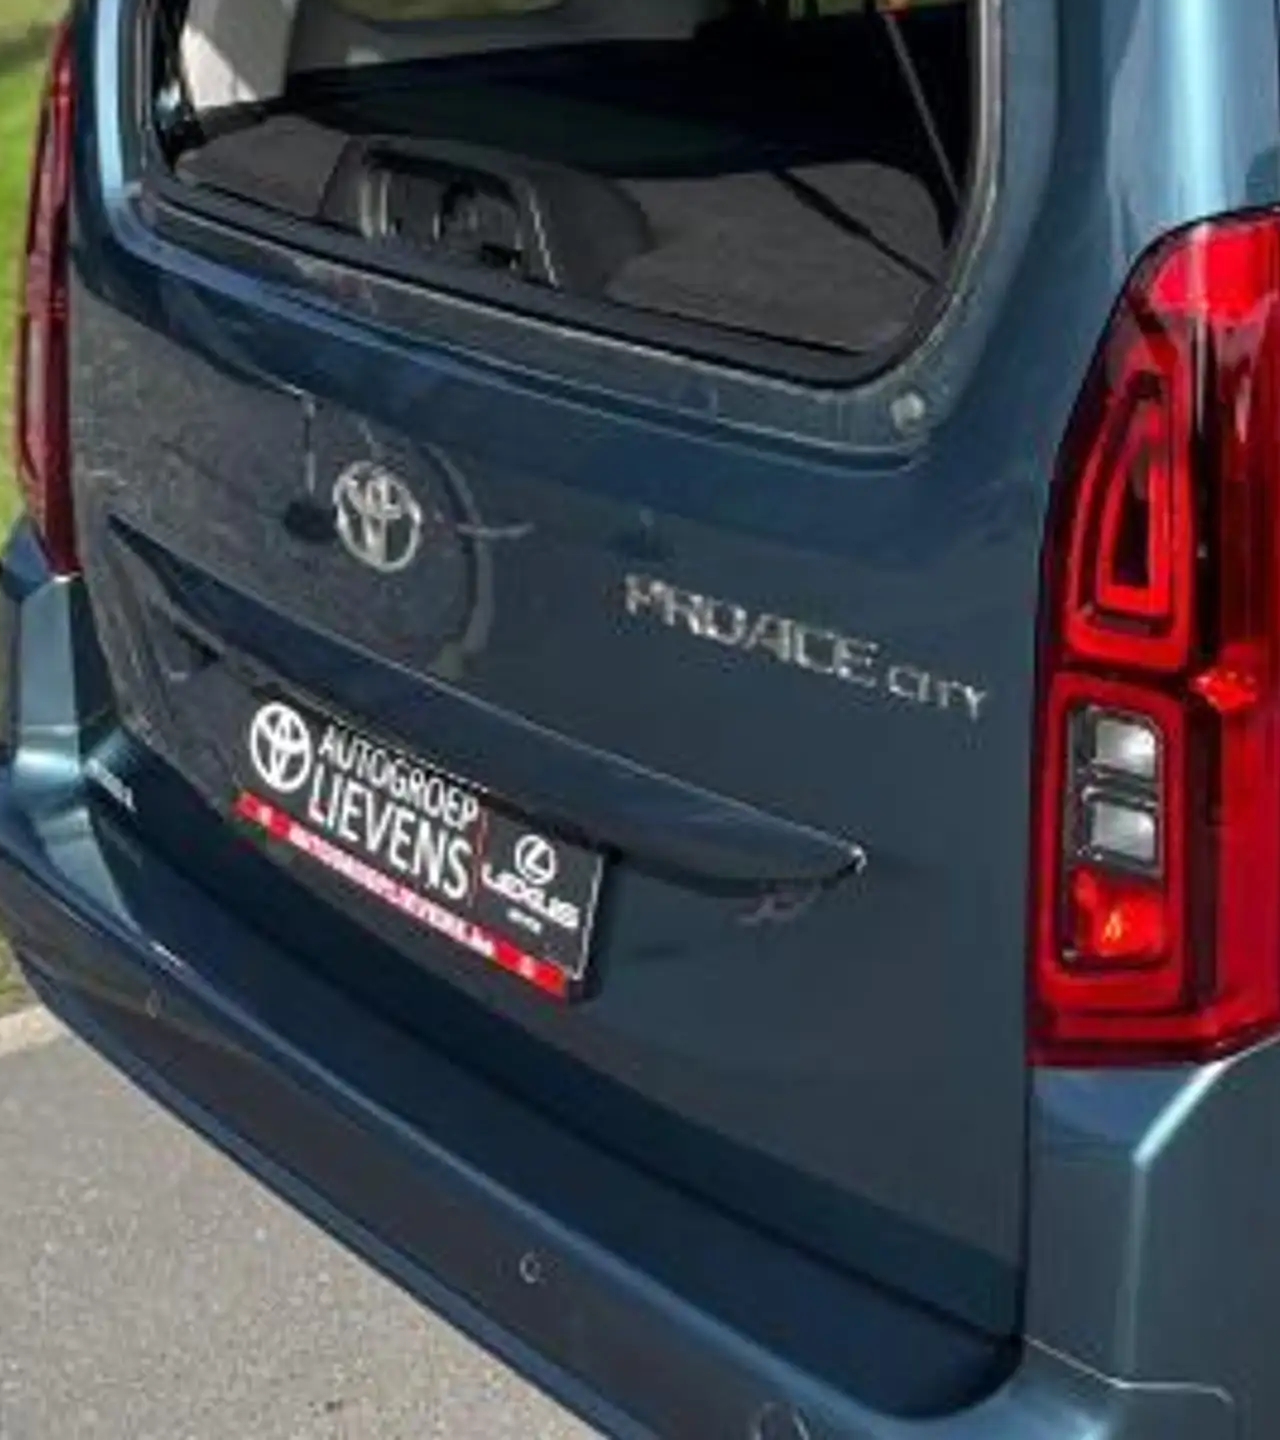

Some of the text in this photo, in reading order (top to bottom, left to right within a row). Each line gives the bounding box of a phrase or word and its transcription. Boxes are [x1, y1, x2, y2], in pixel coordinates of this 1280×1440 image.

[623, 573, 988, 721] PROACE CITY
[308, 762, 475, 901] LIEVENS
[317, 725, 479, 829] AUTOGROEP
